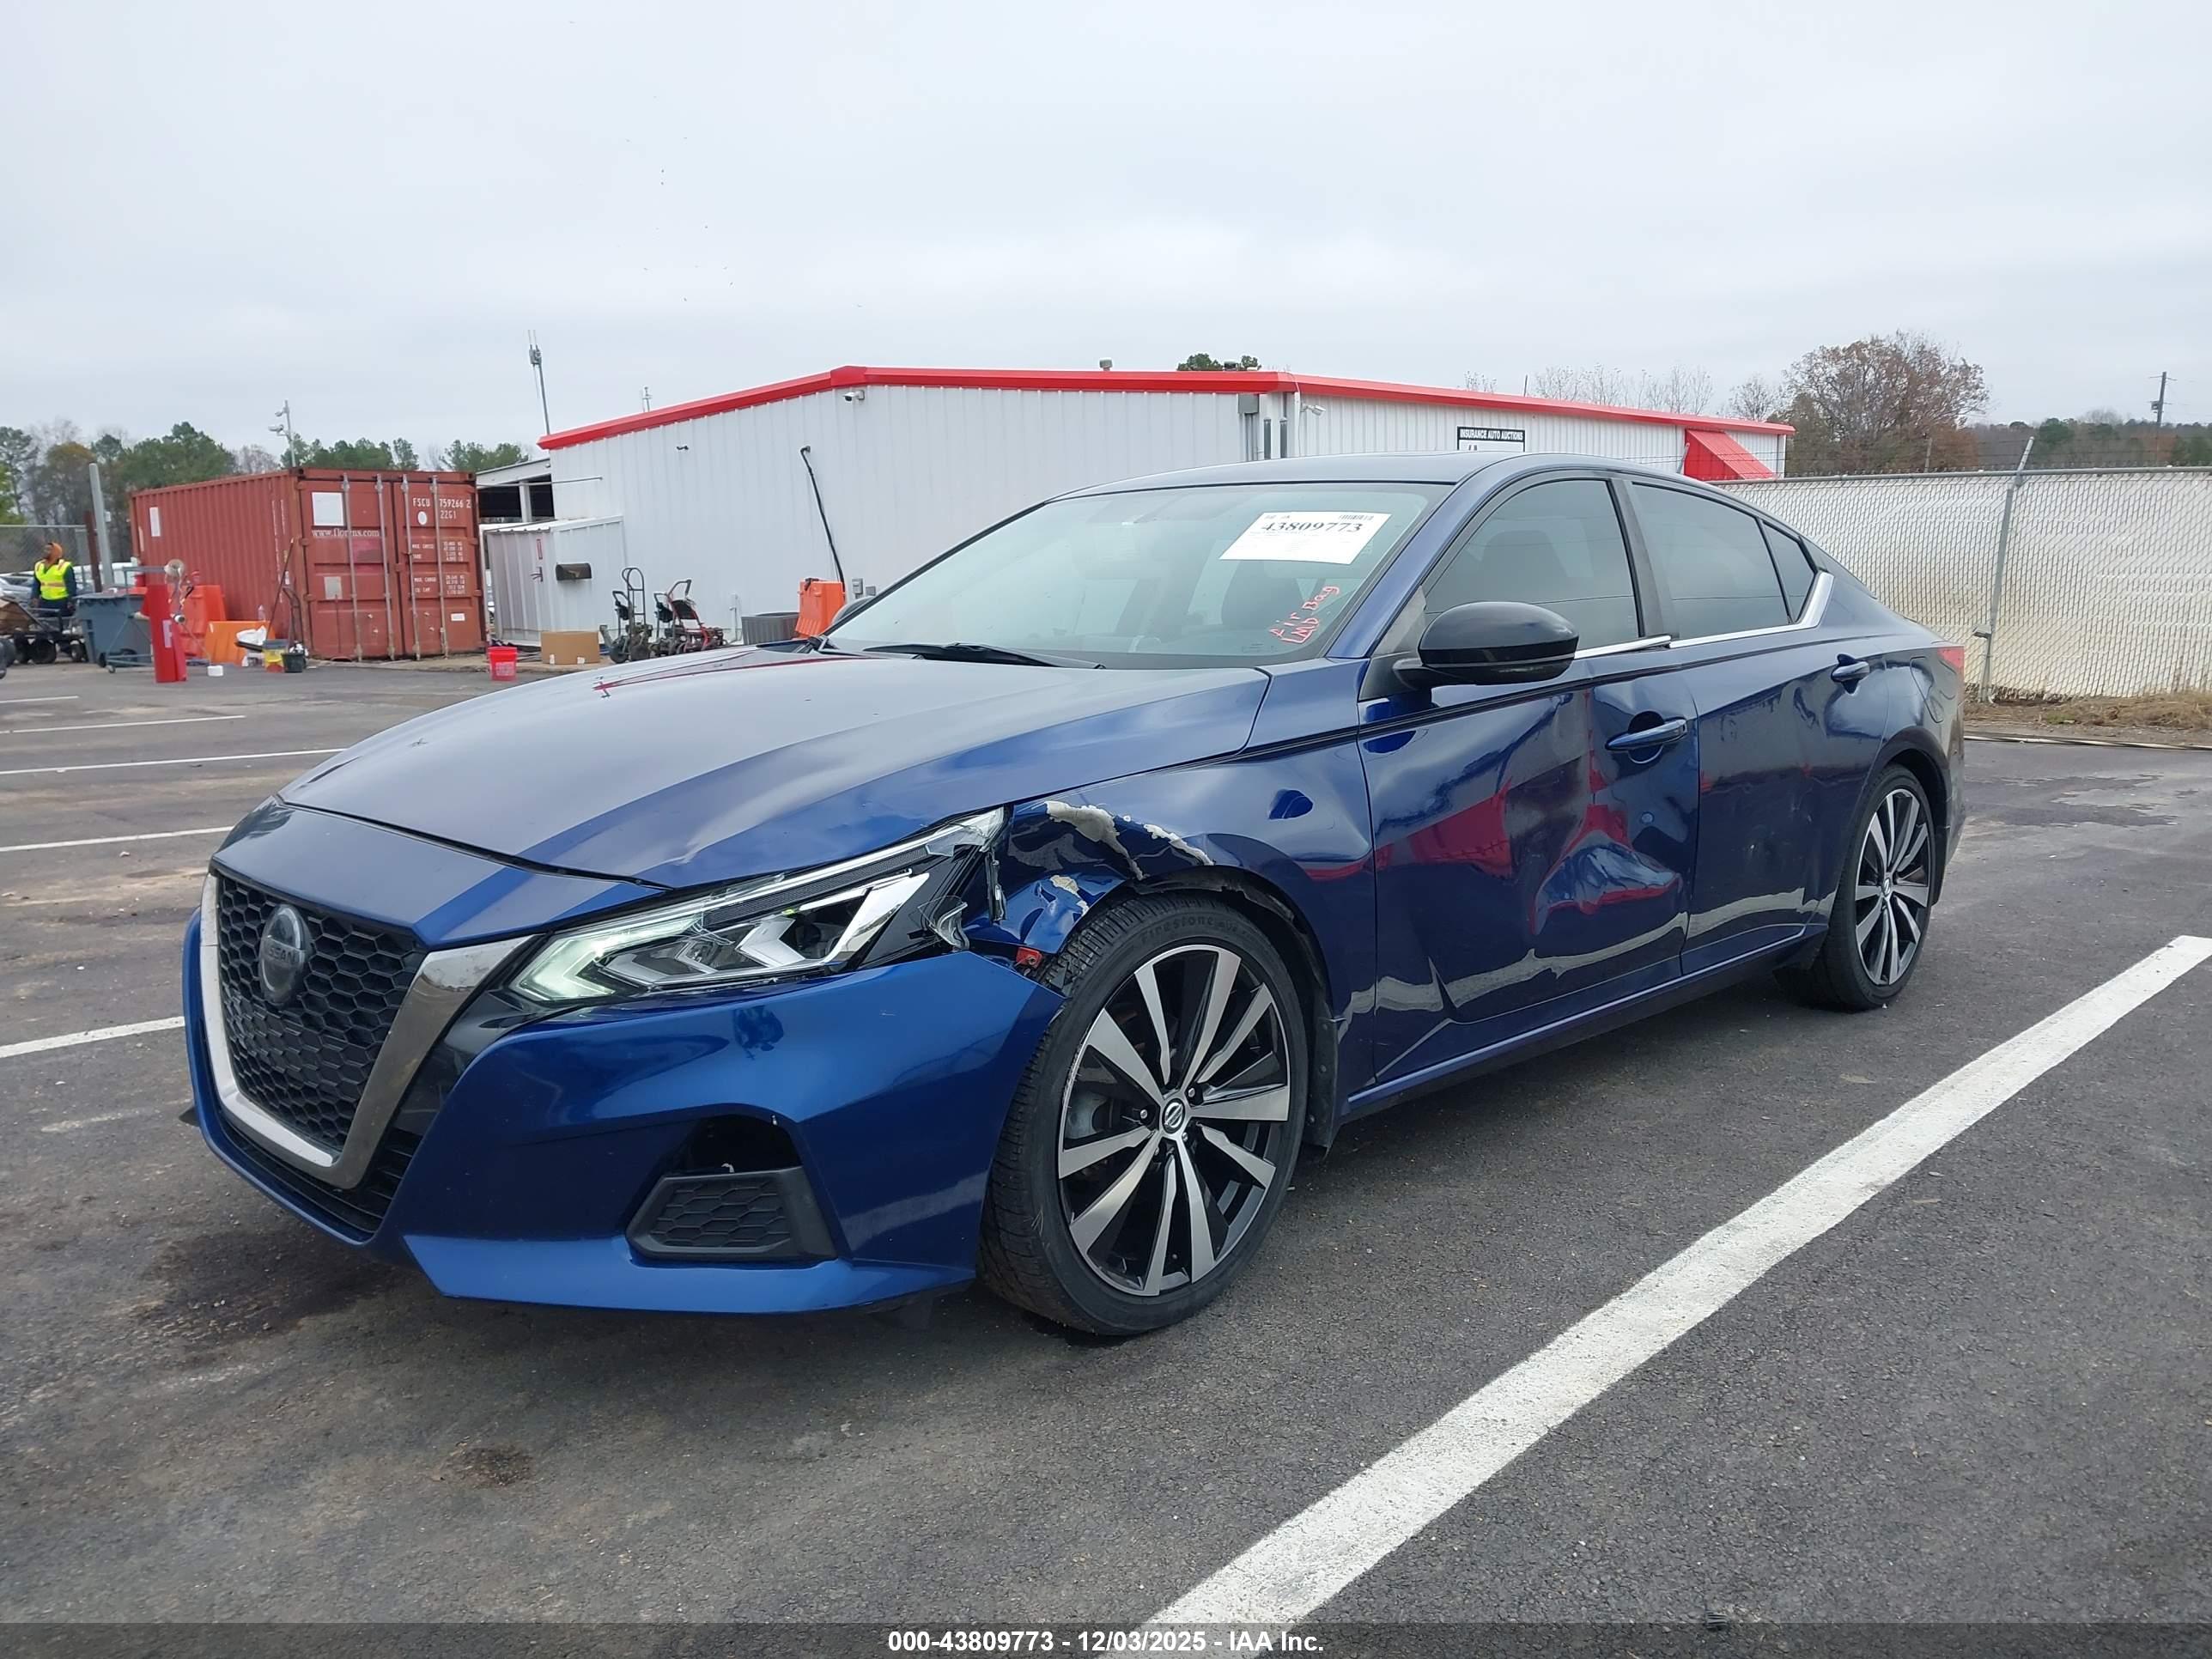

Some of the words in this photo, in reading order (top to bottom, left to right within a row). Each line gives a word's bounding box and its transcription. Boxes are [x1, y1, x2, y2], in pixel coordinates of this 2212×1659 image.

[1460, 428, 1487, 439] INSURANCE
[1487, 429, 1500, 440] AUTO
[1501, 430, 1523, 441] AUCTIONS
[412, 497, 430, 507] FSCU
[311, 527, 380, 537] www.florns.com
[1261, 522, 1364, 532] 43809773
[1268, 611, 1301, 638] Air
[1301, 586, 1340, 611] Bag
